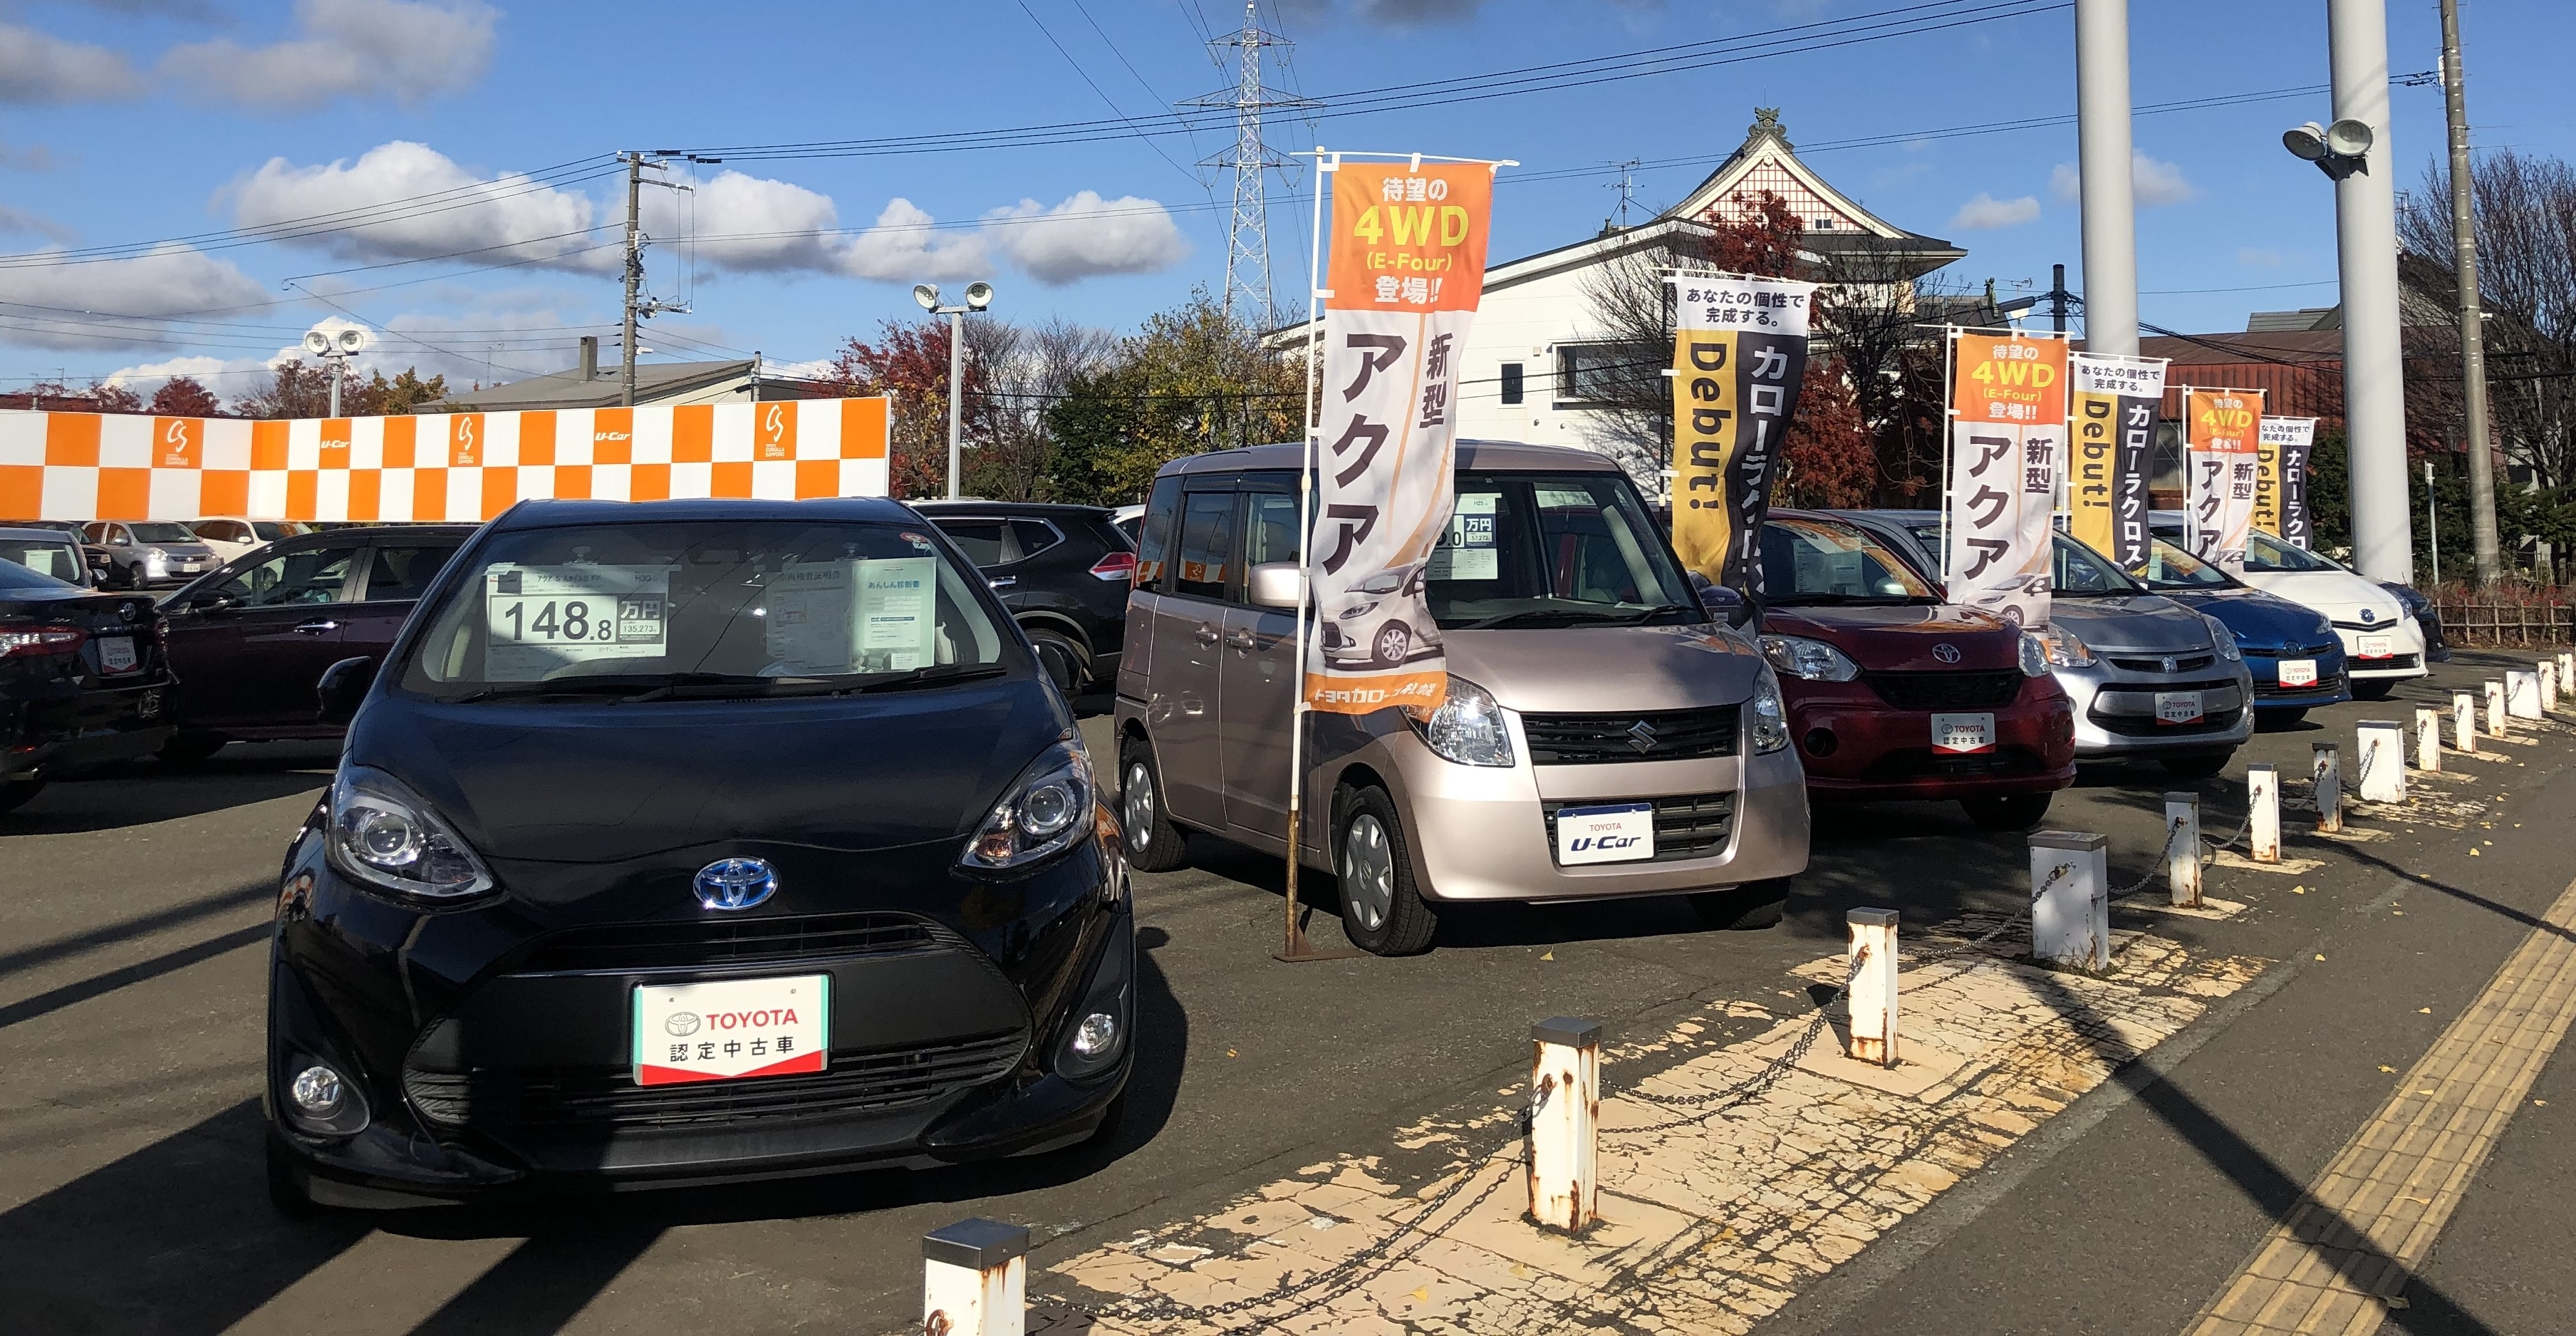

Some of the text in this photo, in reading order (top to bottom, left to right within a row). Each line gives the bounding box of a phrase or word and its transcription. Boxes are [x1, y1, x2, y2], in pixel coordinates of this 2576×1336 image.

[1382, 178, 1448, 202] 待望の
[1354, 205, 1469, 247] 4WD
[1366, 252, 1452, 271] (E-Four)
[1375, 275, 1443, 304] 登場!!
[1686, 288, 1804, 309] あなたの個性で
[1705, 307, 1778, 327] 完成する。
[1993, 344, 2039, 361] 待望の
[1419, 332, 1454, 428] 新型
[1971, 361, 2055, 388] 4WD
[2081, 365, 2160, 380] あなたの個性で
[1983, 388, 2042, 402] (E-Four)
[2094, 378, 2143, 393] 完成する。
[1690, 343, 1732, 510] Debut!
[2201, 409, 2253, 428] 4WD
[2261, 425, 2310, 433] なたの個性で
[321, 440, 350, 449] U-Car
[595, 430, 630, 441] U-Car
[2263, 433, 2297, 442] 完成する。
[1321, 333, 1408, 576] アクア
[2083, 400, 2111, 508] Debut!
[2025, 437, 2054, 494] 新型
[2121, 404, 2151, 566] カローラクロス
[2232, 462, 2254, 500] 新型
[2255, 449, 2276, 527] Debut!
[1963, 435, 2012, 580] アクア
[2198, 461, 2223, 557] アクア
[1466, 518, 1492, 532] 万円
[505, 600, 661, 641] 148.8 万円
[1943, 736, 1985, 745] 認定中古車
[1589, 822, 1622, 832] TOYOTA
[1571, 835, 1641, 851] U-Car
[706, 1008, 799, 1030] TOYOTA
[670, 1035, 794, 1062] 認定中古車
